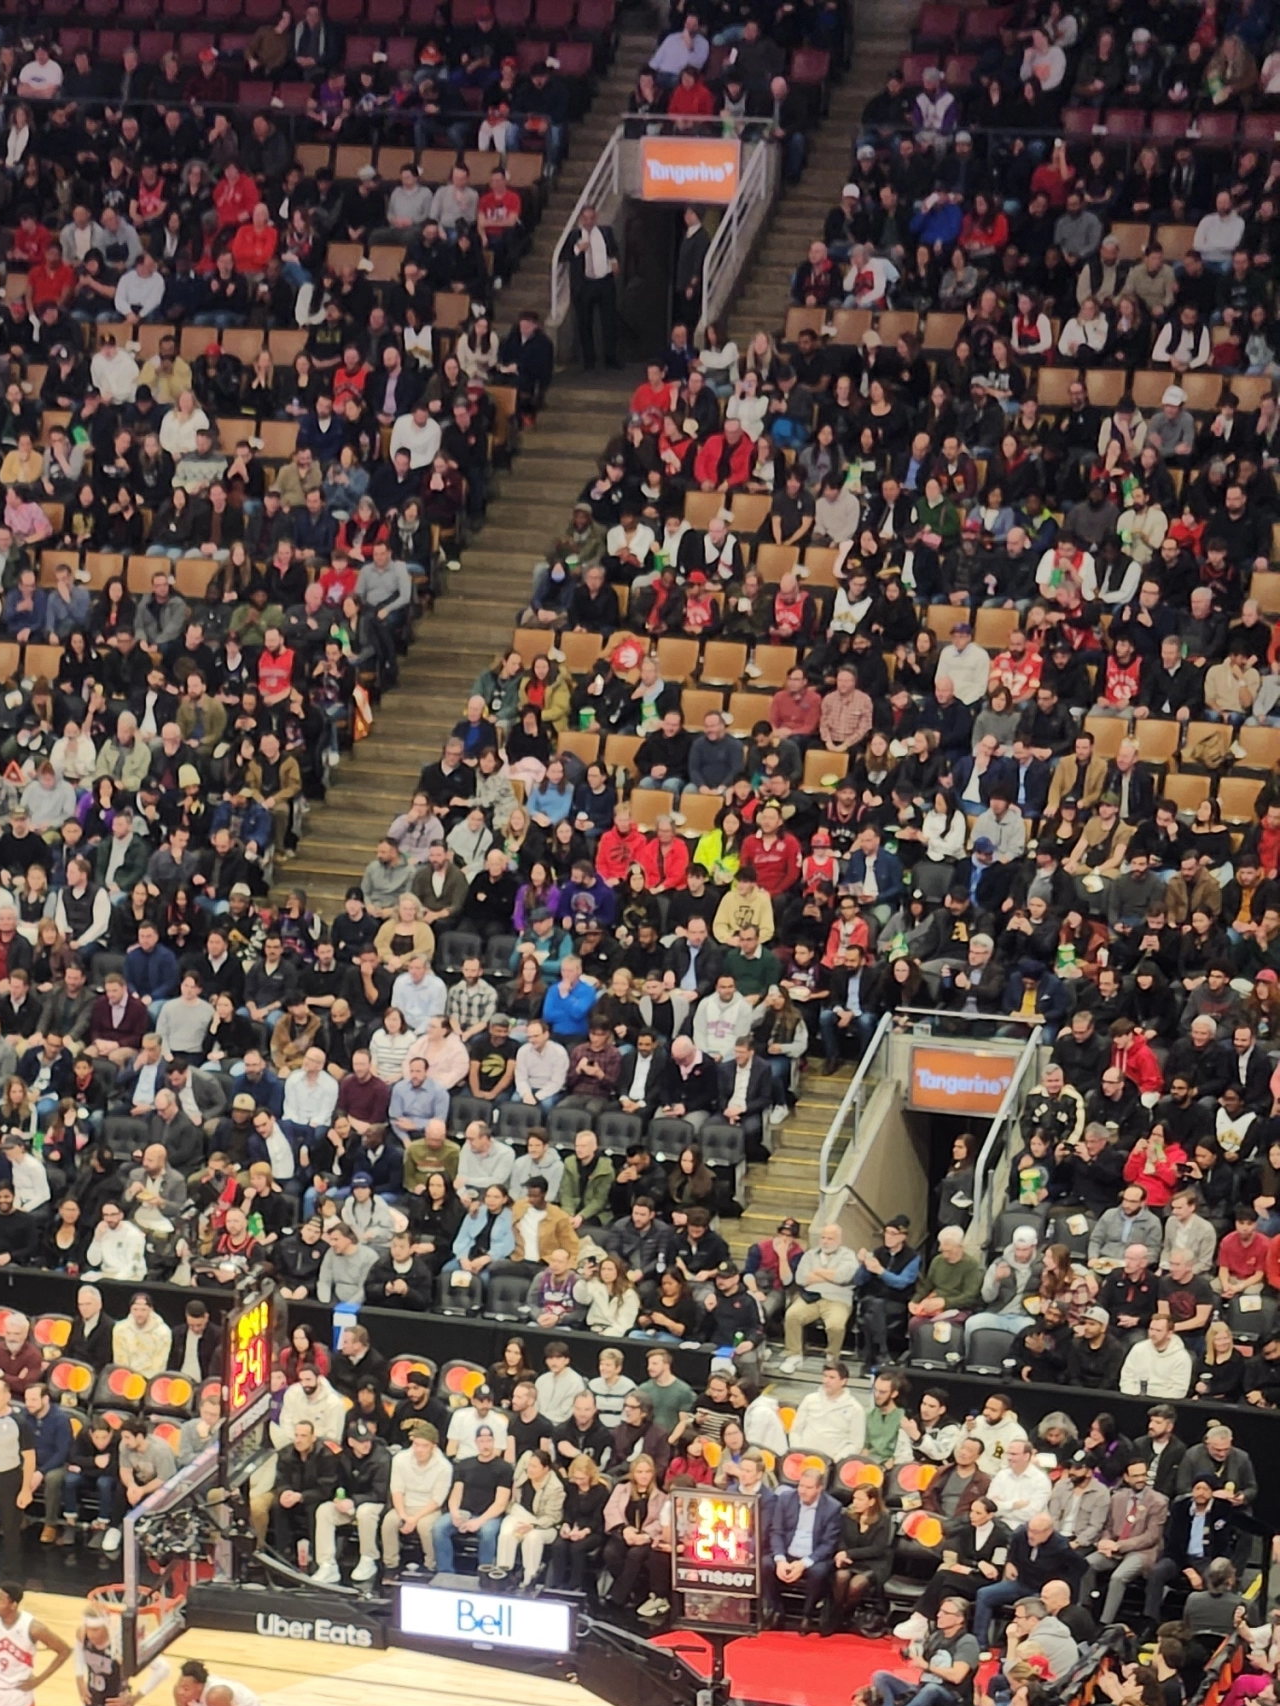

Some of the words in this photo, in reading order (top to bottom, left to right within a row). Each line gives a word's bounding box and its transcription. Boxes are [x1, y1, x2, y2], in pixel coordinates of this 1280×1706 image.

[646, 159, 725, 185] Tangerine
[916, 1068, 1001, 1095] Tangerine
[696, 1527, 736, 1560] 24
[699, 1570, 754, 1588] TISSOT
[256, 1613, 312, 1640] Uber
[315, 1619, 372, 1648] Eats
[457, 1599, 511, 1637] Bell
